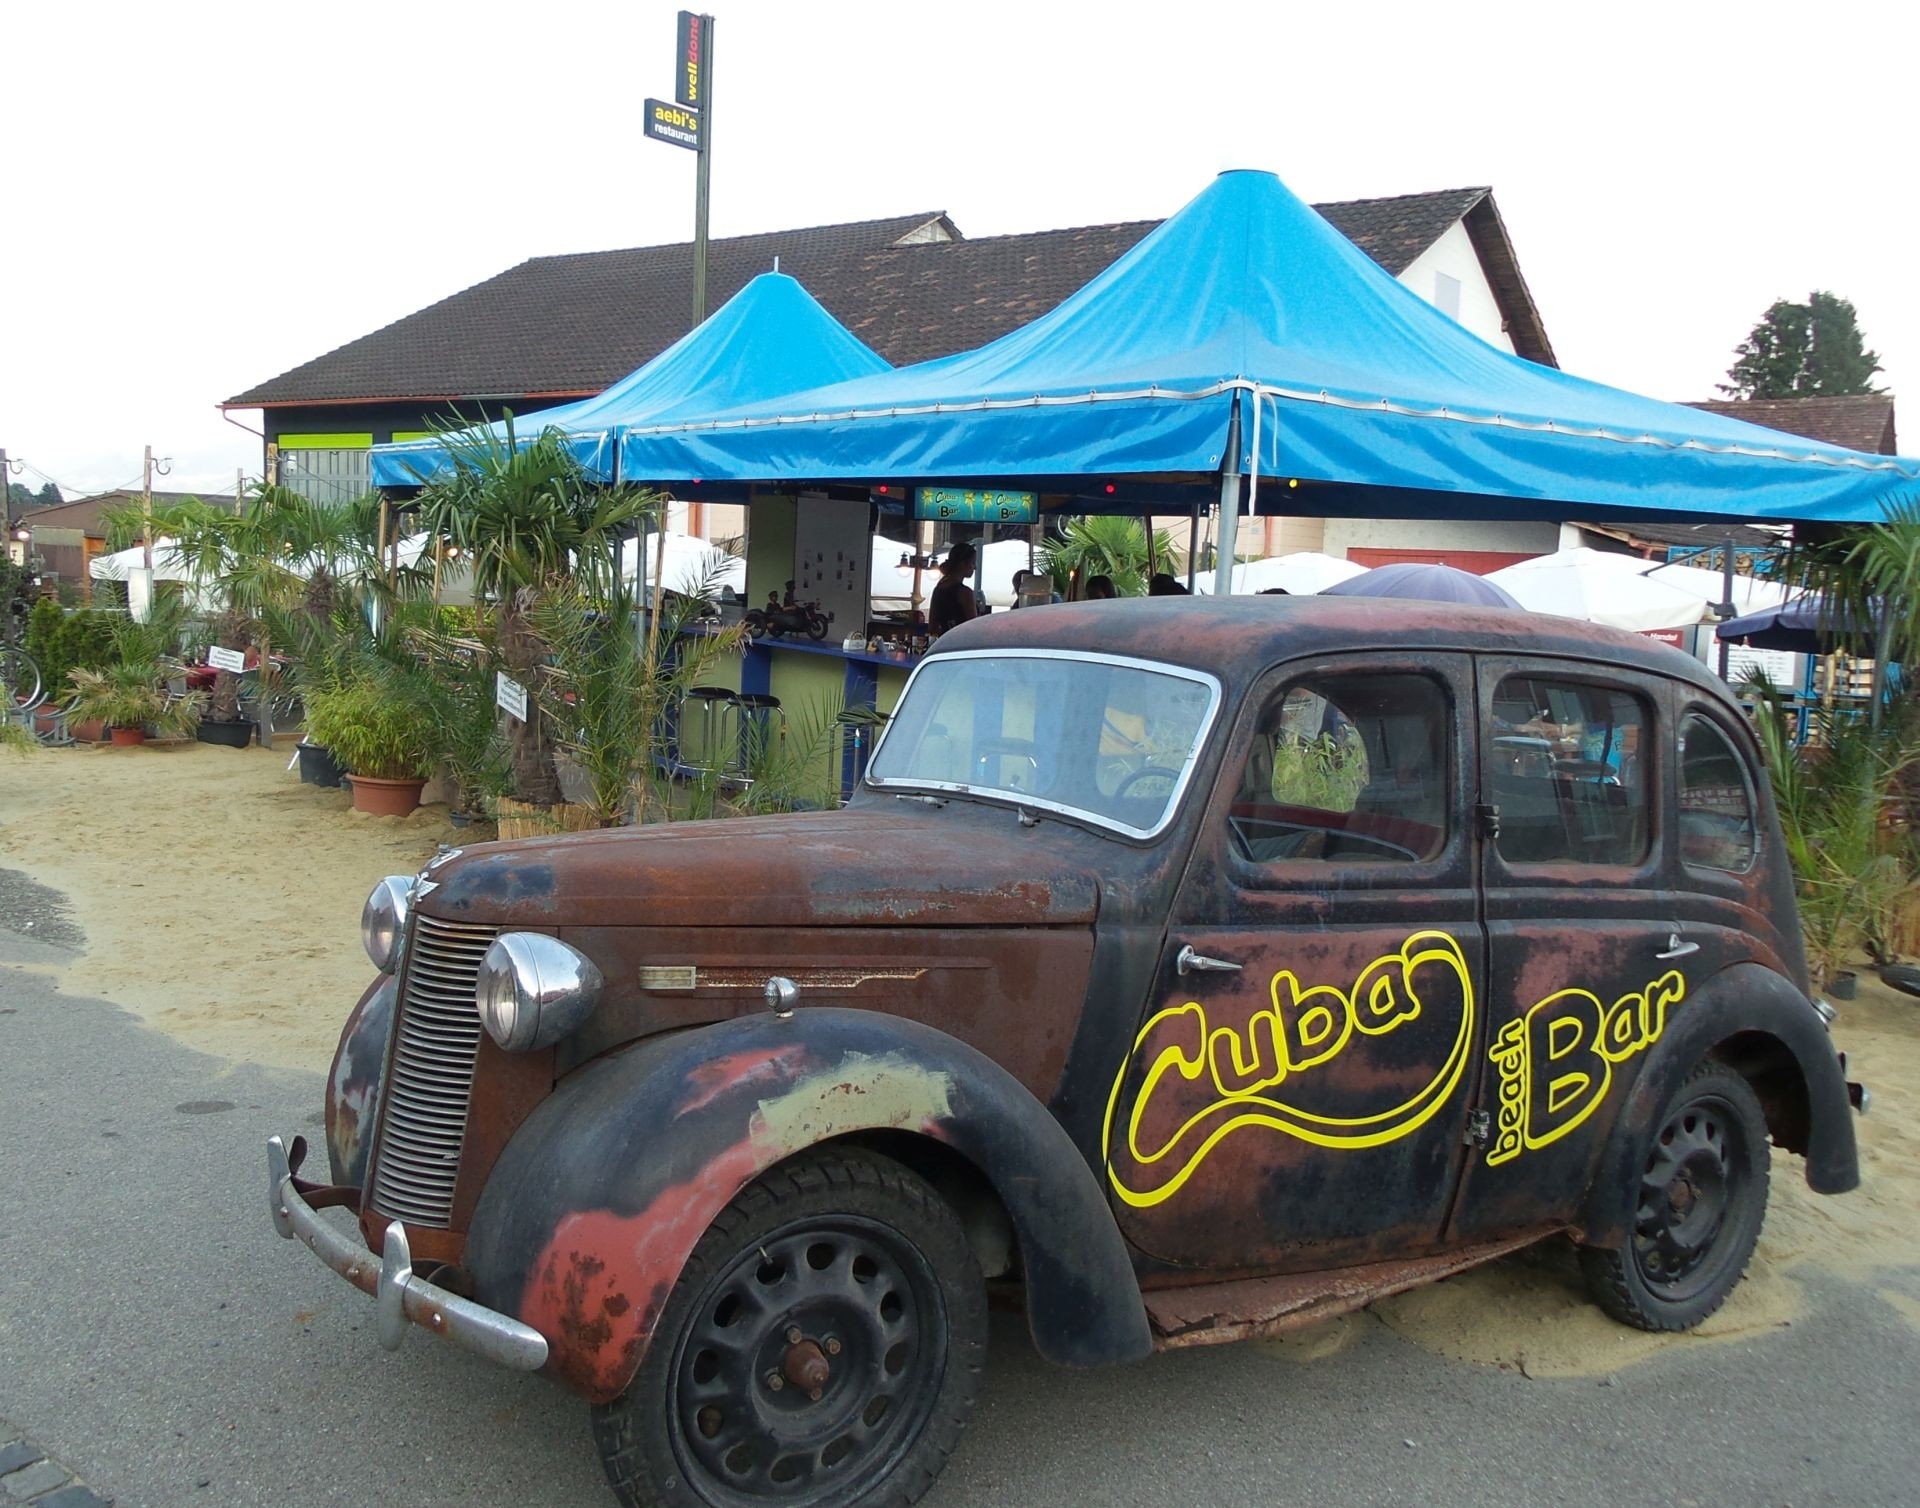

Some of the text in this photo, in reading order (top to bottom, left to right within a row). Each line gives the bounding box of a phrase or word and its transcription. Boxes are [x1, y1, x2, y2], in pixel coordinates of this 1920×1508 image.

[655, 107, 697, 130] aebi's
[654, 123, 697, 144] restaurant
[935, 491, 958, 505] Cuba
[996, 493, 1017, 506] Cuba
[940, 506, 958, 517] Bar
[1001, 508, 1018, 519] Bar
[1102, 930, 1474, 1207] Cuba
[1524, 970, 1685, 1149] Bar
[1487, 1017, 1524, 1166] beach
